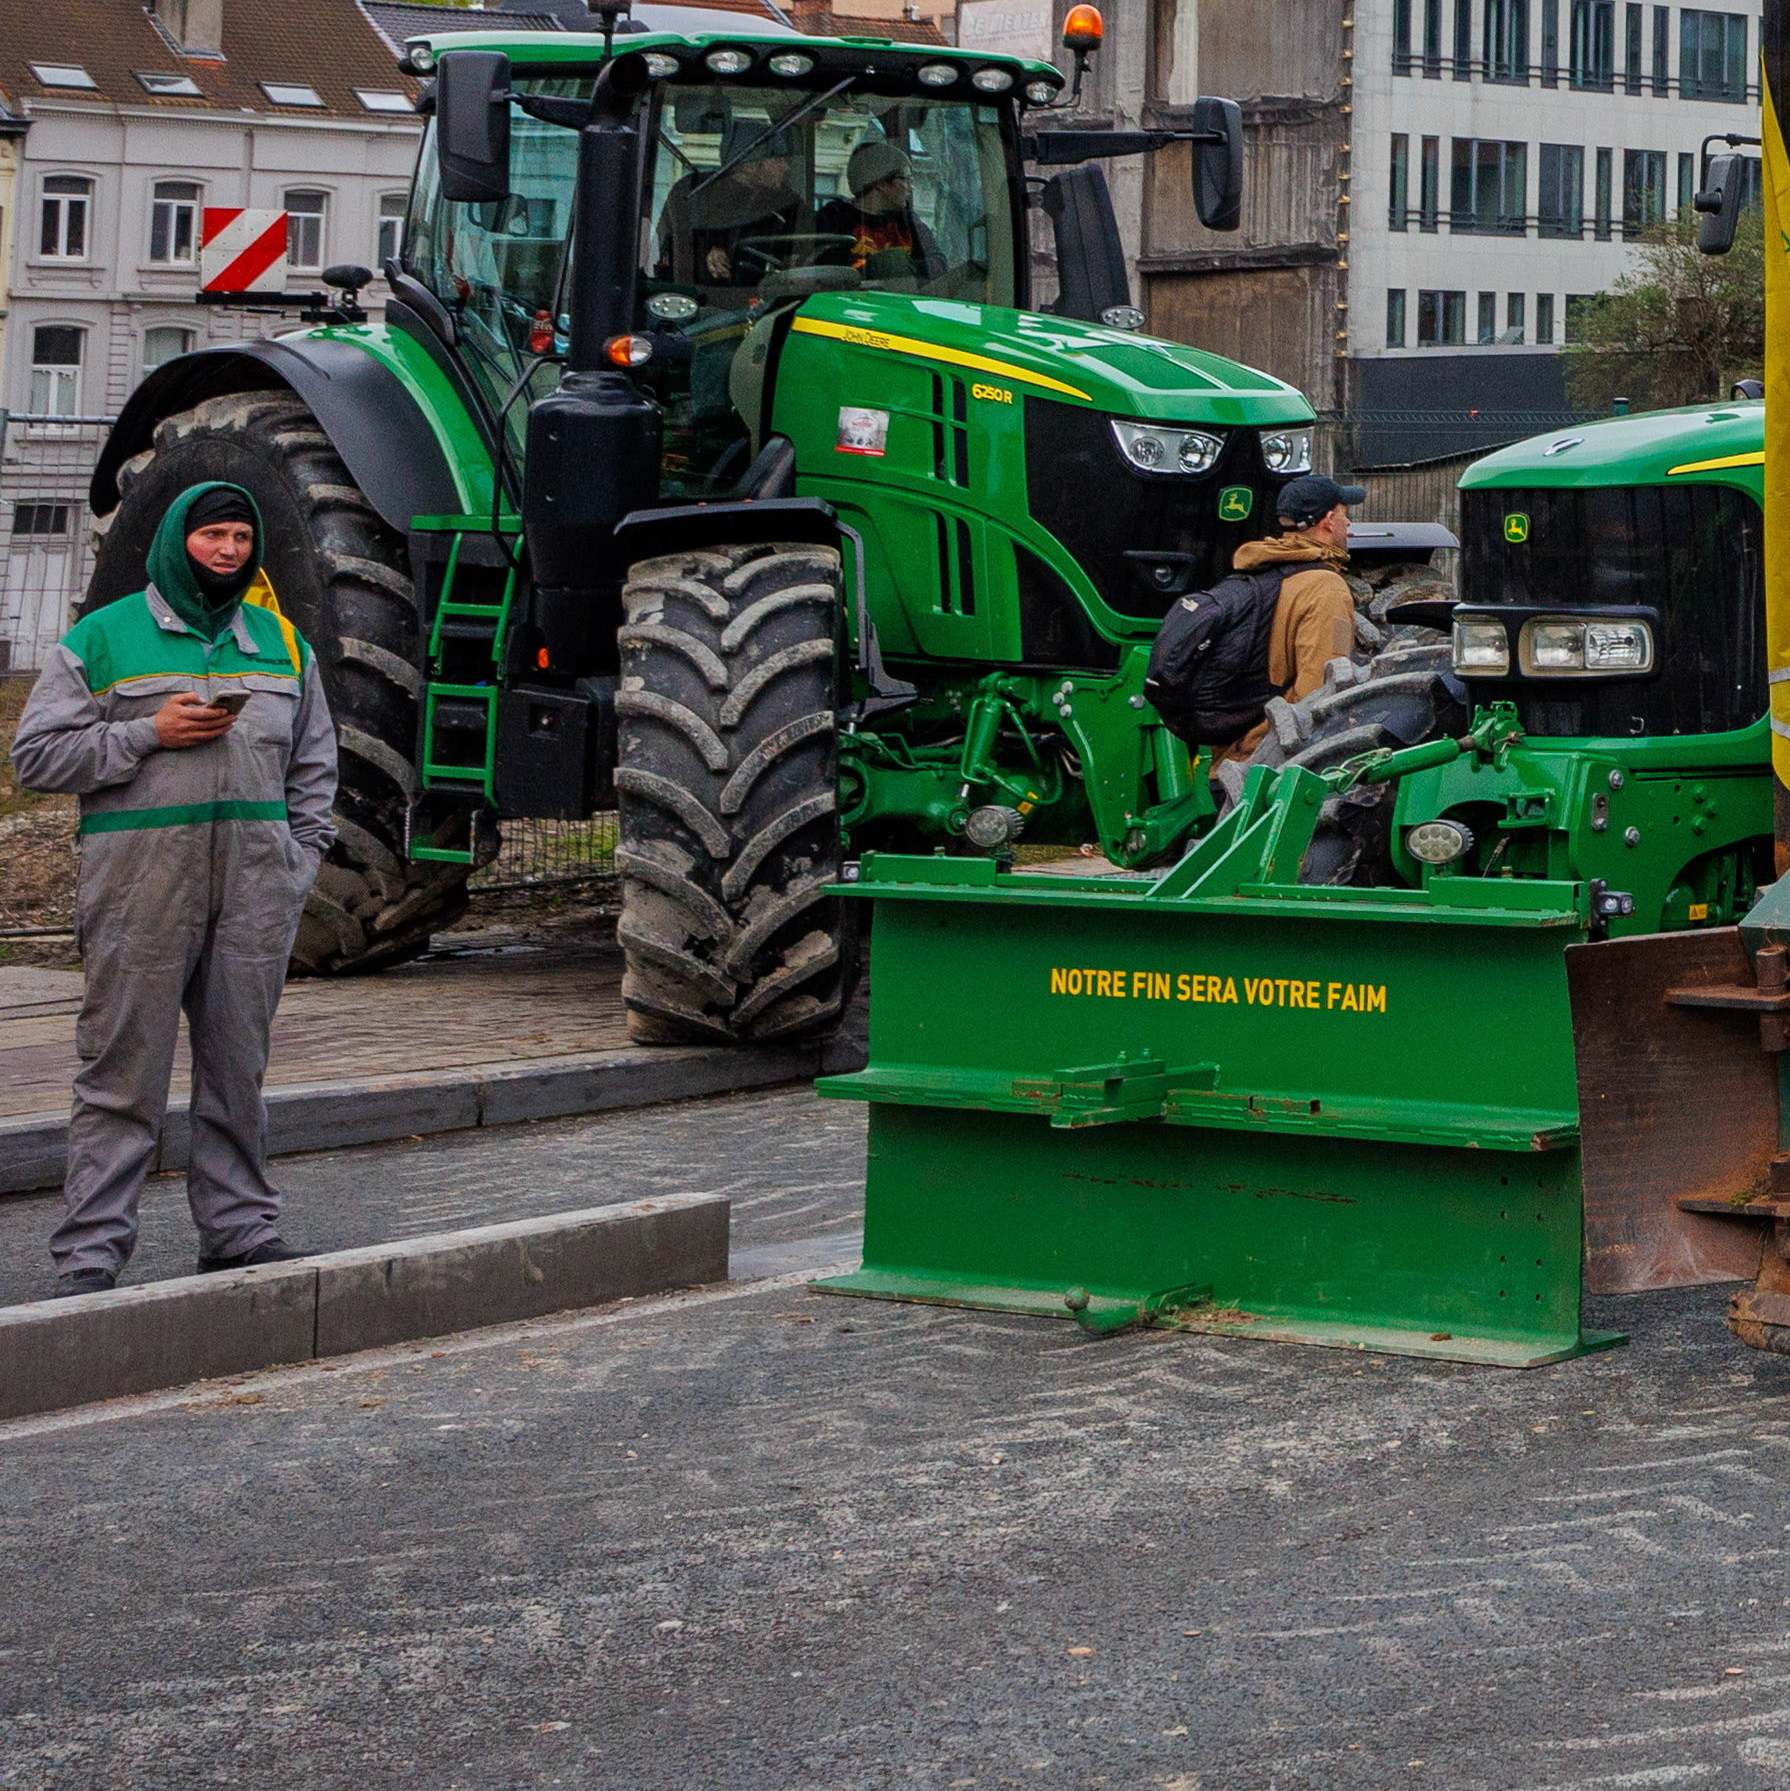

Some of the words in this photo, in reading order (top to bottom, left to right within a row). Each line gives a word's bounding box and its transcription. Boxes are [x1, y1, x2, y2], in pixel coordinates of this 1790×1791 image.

[841, 328, 863, 345] JOHN
[864, 331, 890, 349] DEERE
[1050, 967, 1127, 998] NOTRE
[1132, 971, 1171, 1000] FIN
[1176, 973, 1238, 1005] SERA
[1243, 978, 1321, 1010] VOTRE
[1326, 982, 1387, 1014] FAIM
